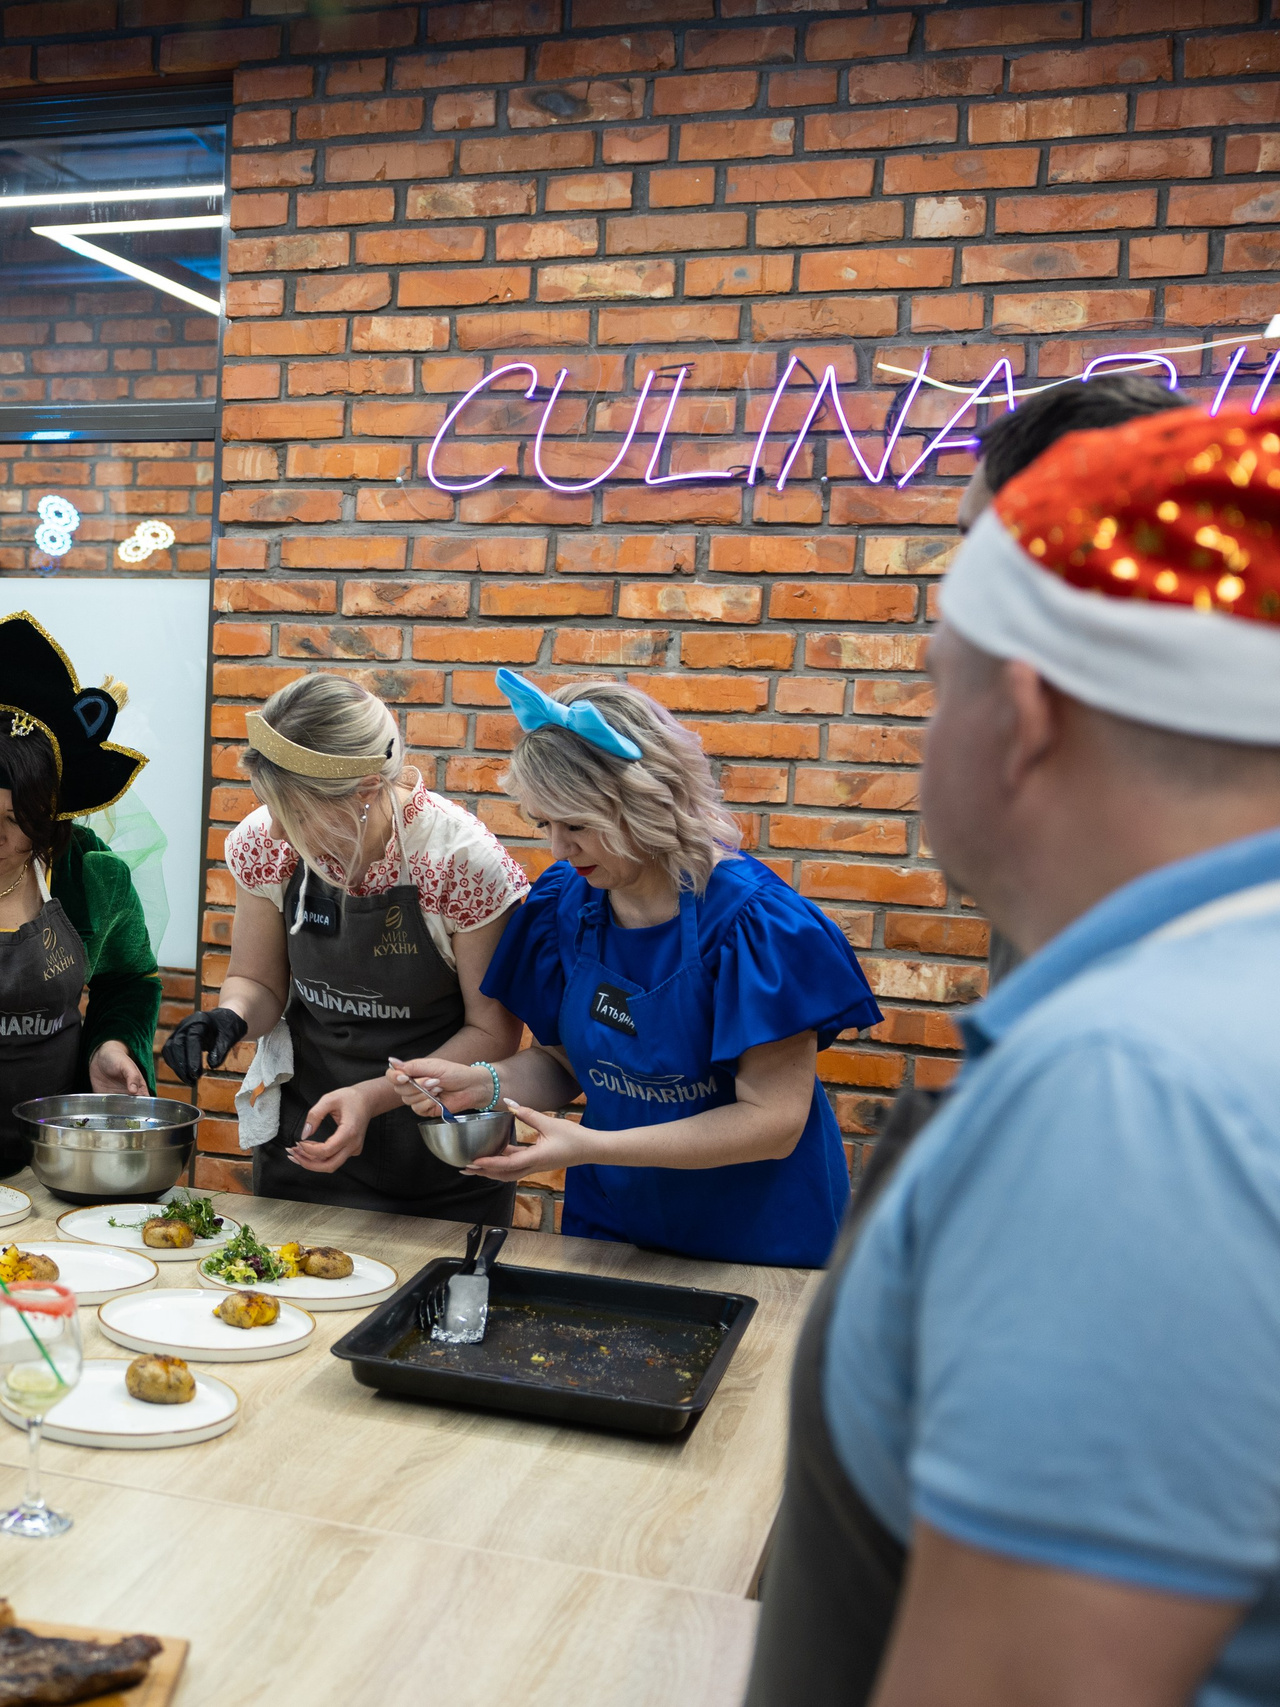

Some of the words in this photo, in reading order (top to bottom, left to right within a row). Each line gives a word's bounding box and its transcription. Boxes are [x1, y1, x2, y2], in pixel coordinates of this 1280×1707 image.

[381, 930, 408, 944] МИР
[45, 946, 66, 968] МИР
[373, 942, 419, 957] КУХНИ
[43, 954, 75, 981] КУХНИ
